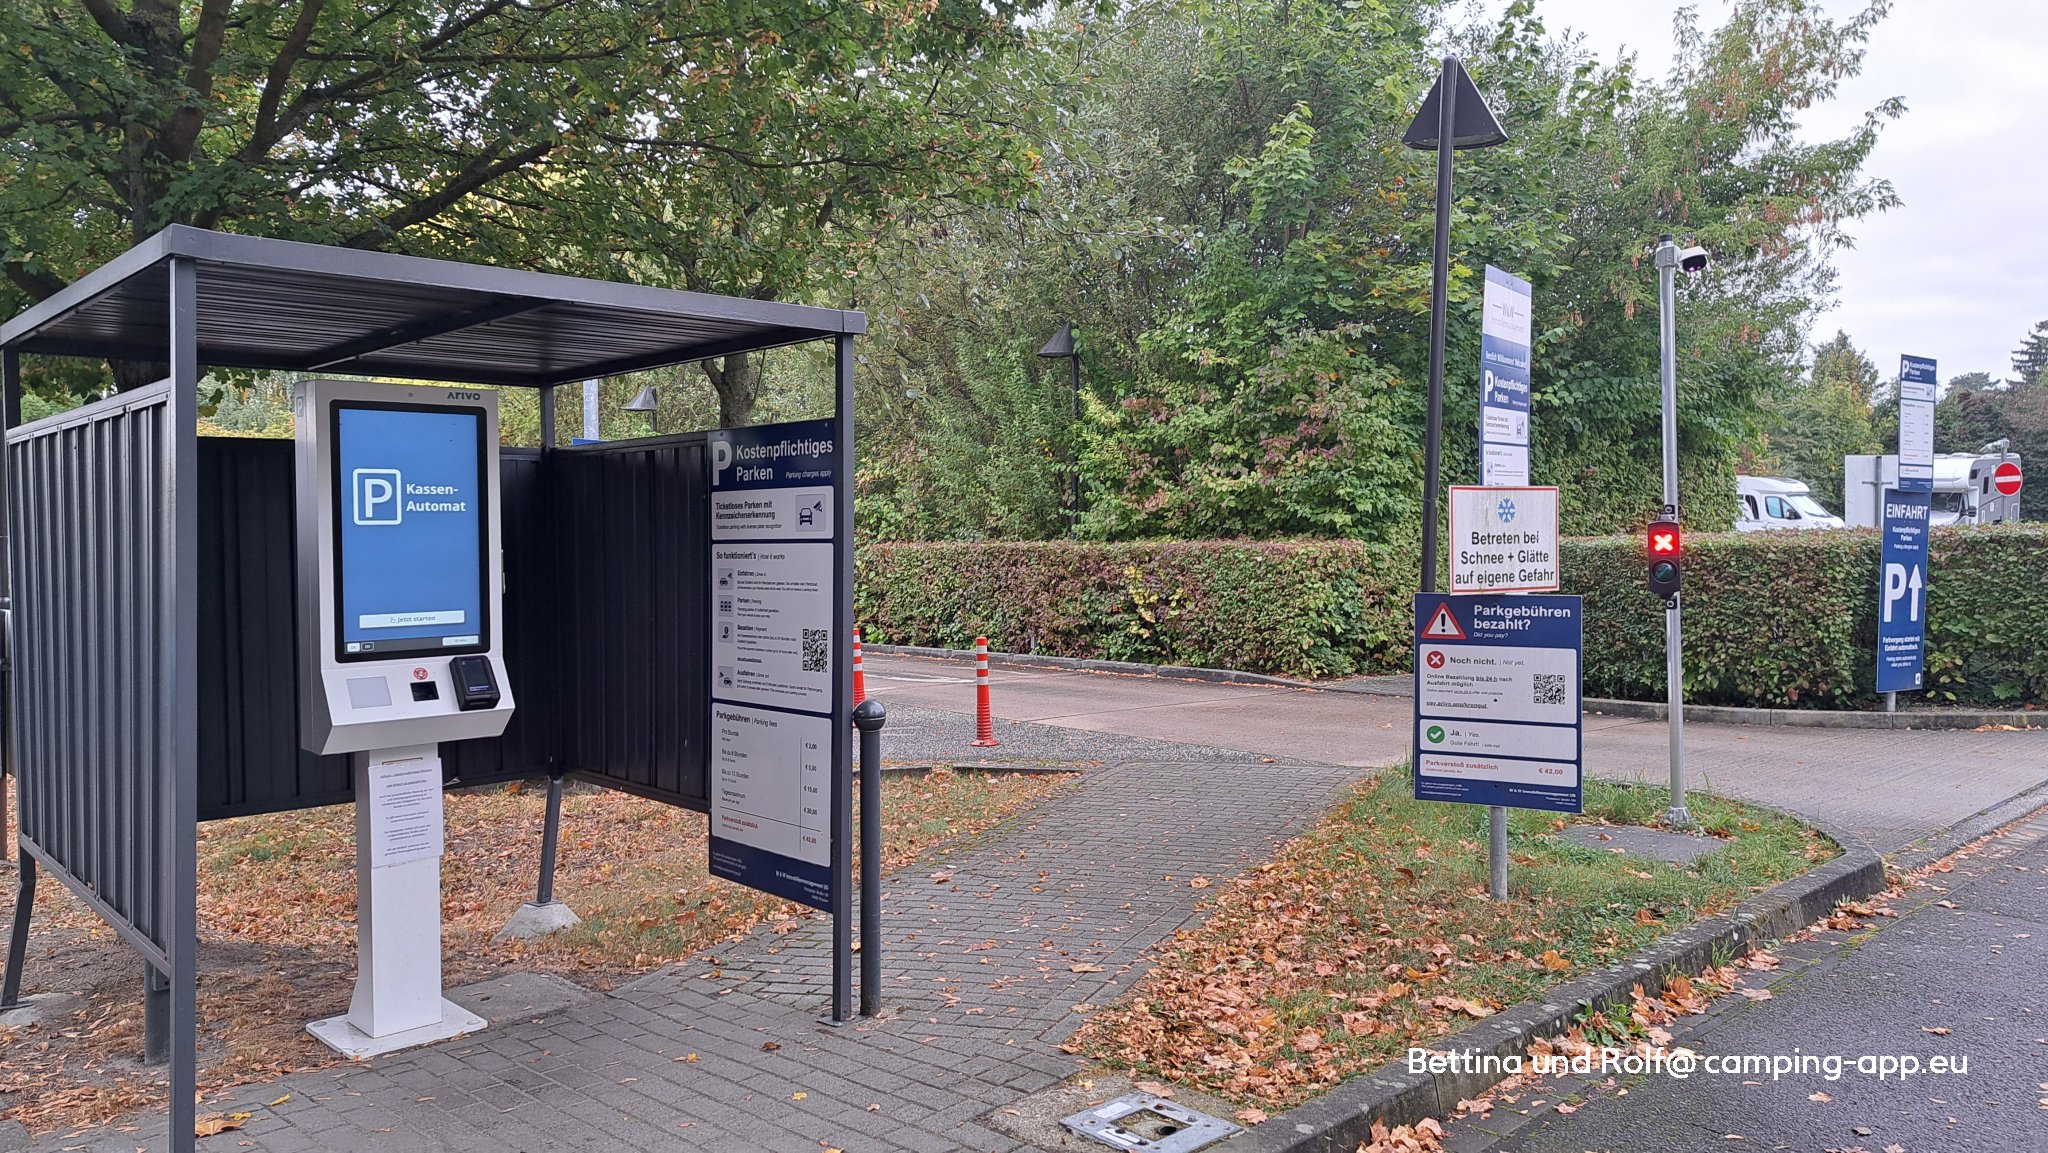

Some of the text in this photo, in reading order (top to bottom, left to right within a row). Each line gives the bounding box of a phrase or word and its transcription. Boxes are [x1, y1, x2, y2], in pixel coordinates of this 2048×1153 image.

[1901, 359, 1910, 379] P
[1484, 369, 1494, 403] P
[736, 437, 833, 462] Kostenpflichtiges
[712, 440, 733, 486] P
[736, 465, 774, 482] Parken
[785, 469, 832, 480] Parking charges apply
[406, 483, 459, 496] Kassen-
[363, 478, 393, 518] P
[406, 500, 466, 513] Automat
[715, 500, 773, 511] Ticketloses Parken mit
[1886, 503, 1929, 520] EINFAHRT
[715, 510, 776, 520] Kennzeichenerkennung
[1471, 530, 1540, 545] Betreten bei
[716, 552, 723, 560] So
[760, 552, 769, 560] How
[1460, 551, 1504, 565] Schnee
[1517, 549, 1549, 563] Glätte
[1455, 568, 1555, 587] auf eigene Gefahr
[1883, 562, 1908, 623] P
[1473, 604, 1571, 619] Parkgebühren
[1473, 618, 1531, 631] bezahlt?
[1449, 656, 1472, 665] Noch
[1473, 657, 1497, 666] nicht.
[1445, 674, 1475, 682] Bezahlung
[1475, 675, 1485, 683] bis
[1451, 680, 1474, 688] möglich
[716, 710, 751, 724] Parkgebühren
[1450, 729, 1462, 737] Ja.
[1425, 759, 1499, 771] Parkverstoß zusätzlich
[1544, 768, 1564, 776] 42,00
